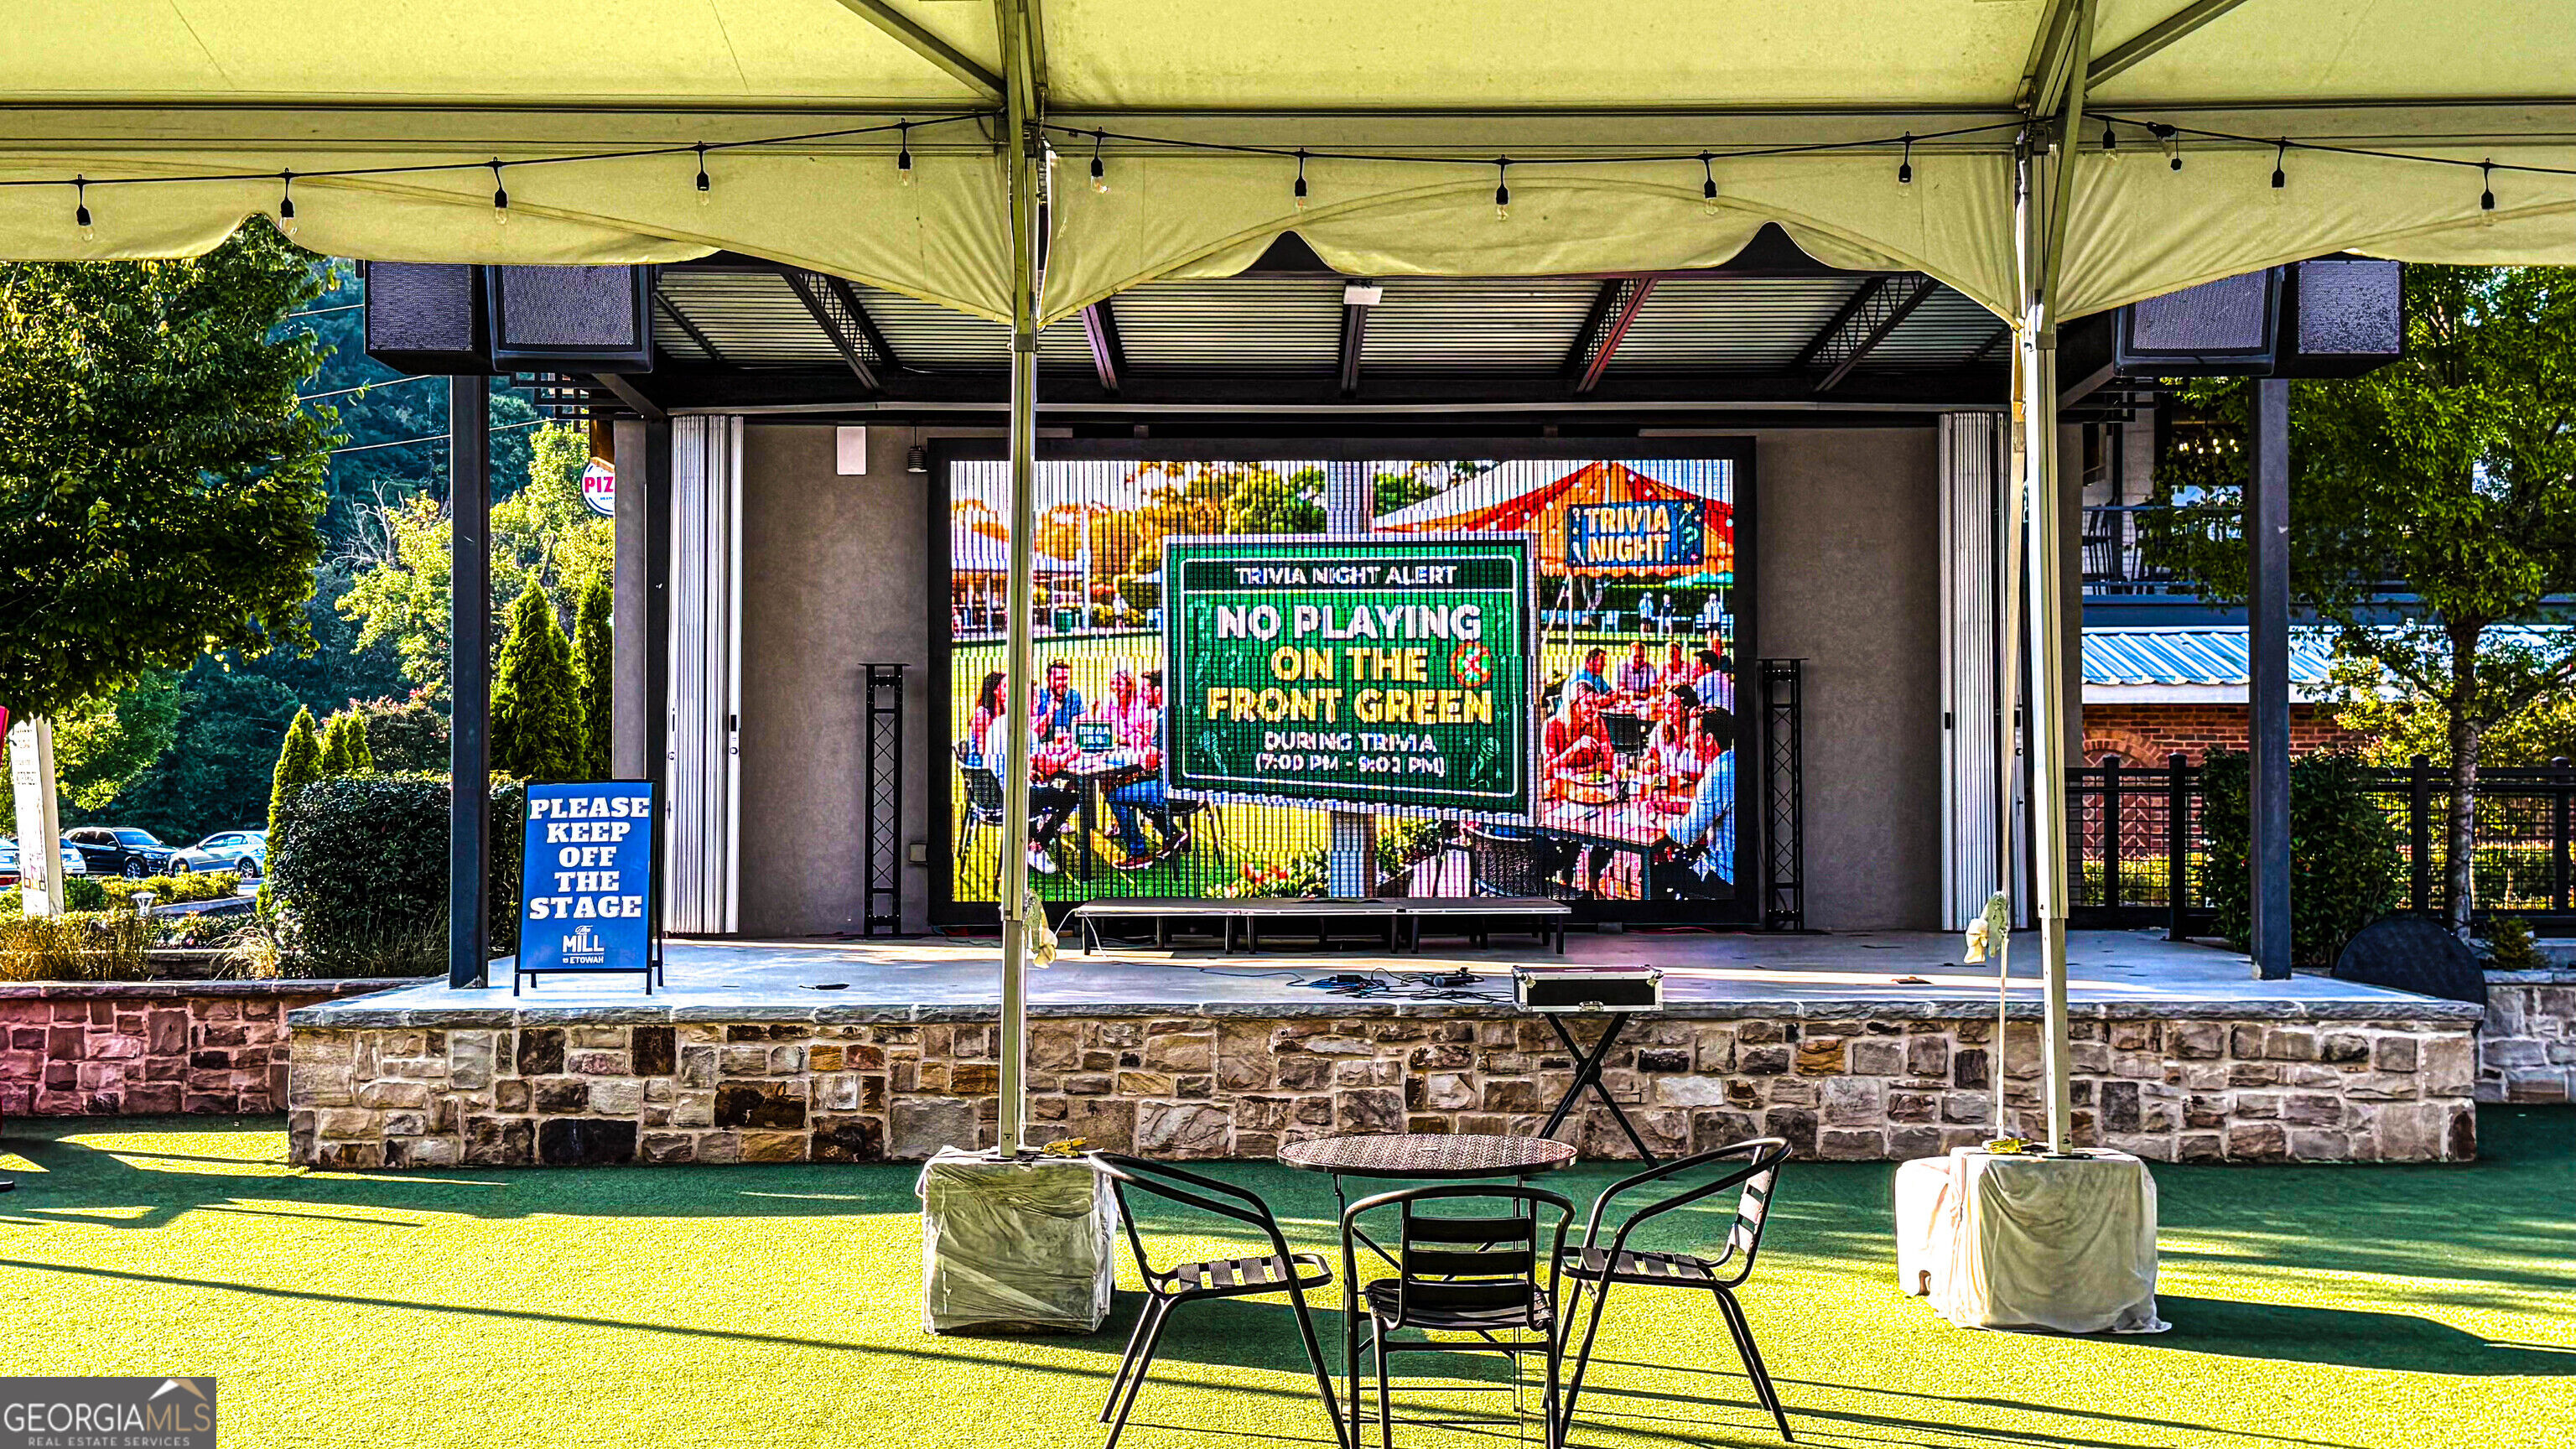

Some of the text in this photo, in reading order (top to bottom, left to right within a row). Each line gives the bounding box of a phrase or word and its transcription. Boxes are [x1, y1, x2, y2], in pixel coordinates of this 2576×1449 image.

[584, 476, 617, 493] PIZ
[1584, 506, 1671, 533] TRIVIA
[1587, 533, 1671, 563] NIGHT
[1235, 565, 1457, 585] TRIVIA NIGHT ALERT
[1217, 605, 1483, 641] NO PLAYING
[1270, 647, 1428, 683] ON THE
[1207, 688, 1493, 725] FRONT GREEN
[1264, 731, 1438, 753] DURING TRIVIA
[1255, 752, 1305, 772] (7:00
[1309, 755, 1339, 771] PM
[1408, 756, 1446, 777] PM)
[529, 797, 651, 820] PLEASE
[546, 822, 631, 843] KEEP
[558, 846, 617, 868] OFF
[554, 870, 620, 892] THE
[529, 896, 642, 920] STAGE
[562, 934, 605, 953] MILL
